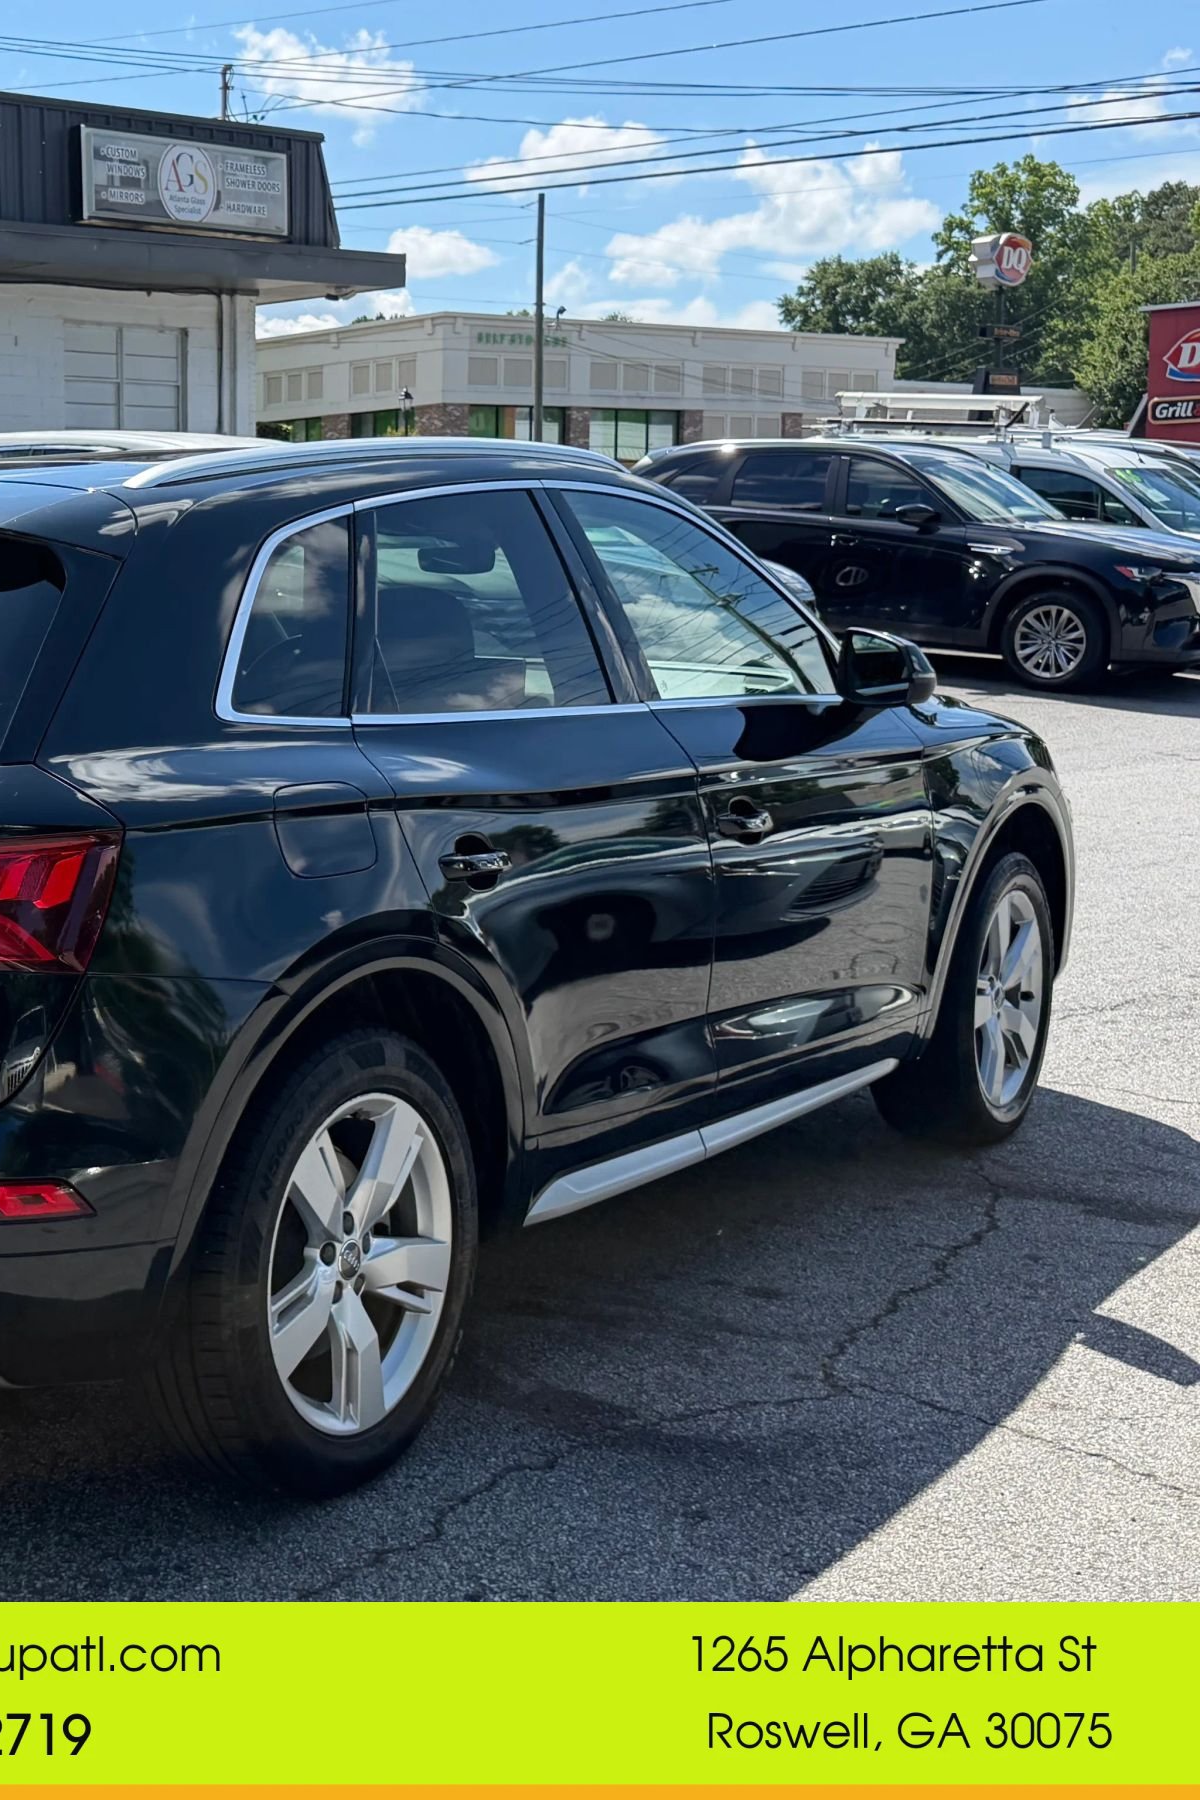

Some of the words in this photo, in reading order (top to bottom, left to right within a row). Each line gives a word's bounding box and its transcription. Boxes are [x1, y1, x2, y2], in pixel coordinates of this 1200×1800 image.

[106, 146, 137, 159] CUSTOM
[107, 162, 145, 178] WINDOWS
[164, 152, 209, 195] AGS
[225, 161, 266, 176] FRAMELESS
[225, 177, 256, 190] SHOWER
[257, 181, 280, 193] DOORS
[109, 189, 144, 203] MIRRORS
[226, 202, 266, 216] HARDWARE
[1002, 246, 1026, 273] DQ
[1155, 401, 1194, 418] Grill
